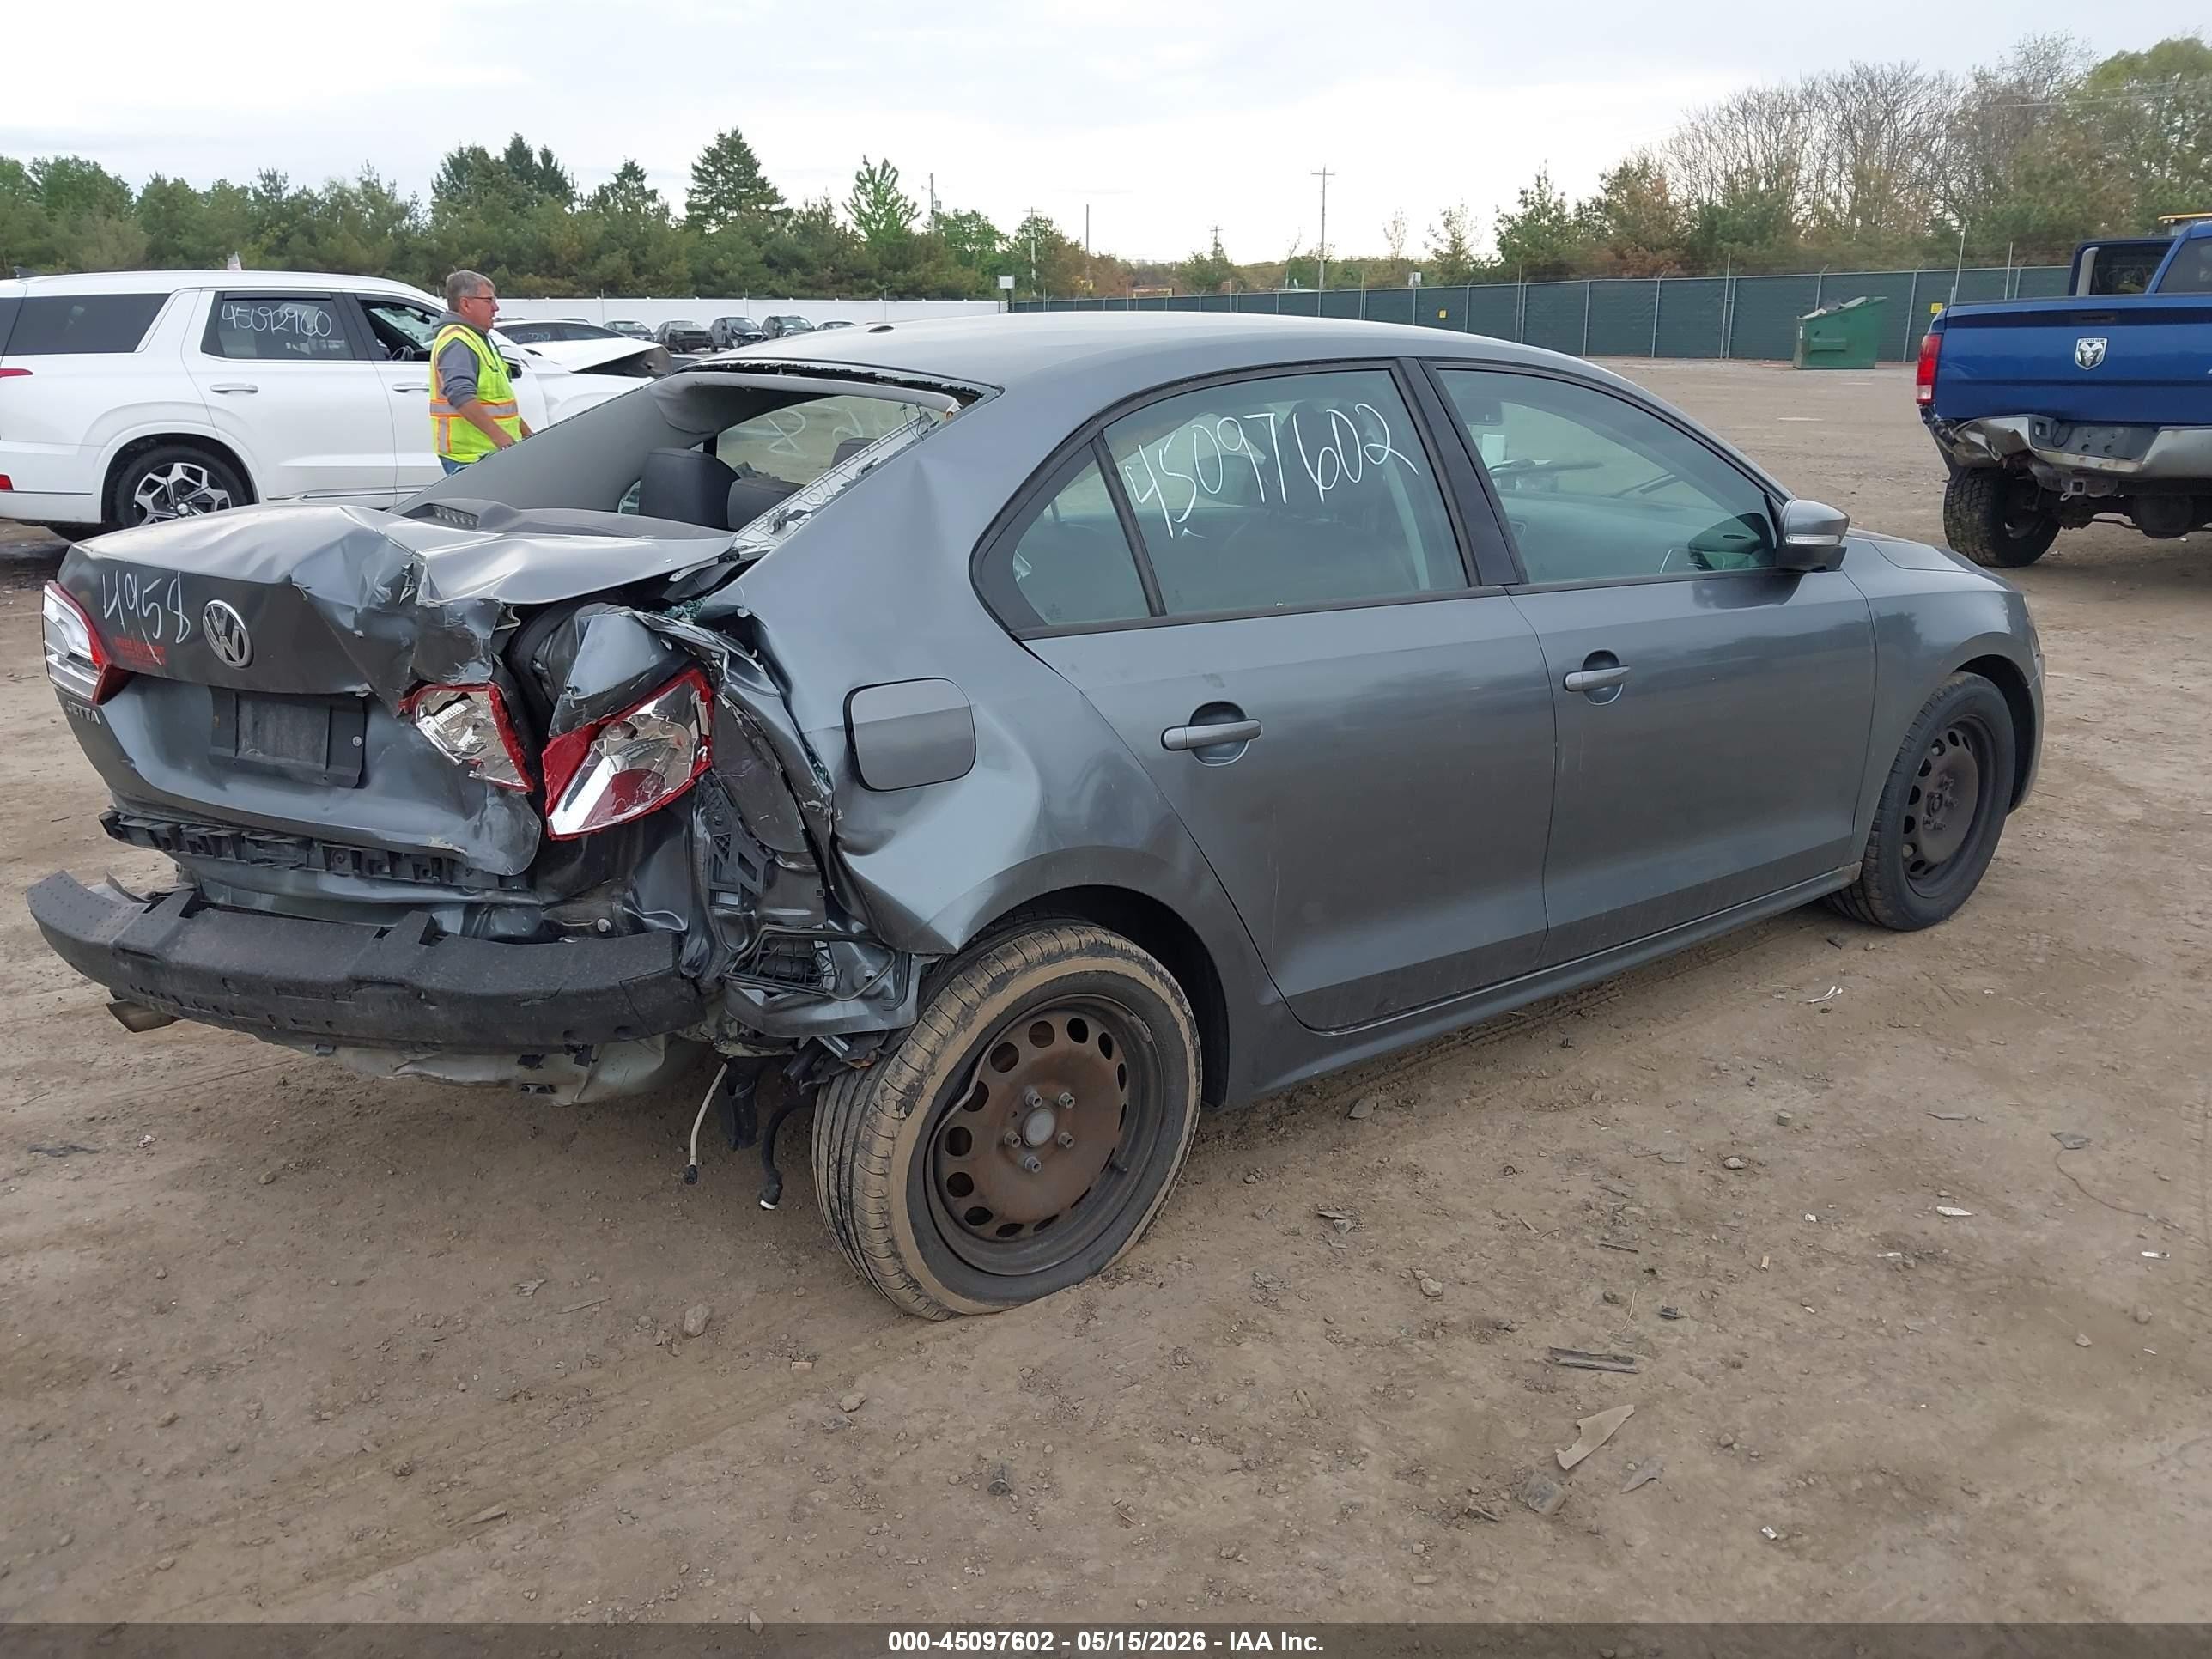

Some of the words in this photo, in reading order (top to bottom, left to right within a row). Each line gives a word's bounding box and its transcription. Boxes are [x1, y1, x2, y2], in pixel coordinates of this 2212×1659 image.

[222, 304, 332, 337] 45092960
[1124, 403, 1419, 538] 45097602
[102, 569, 191, 666] 4958
